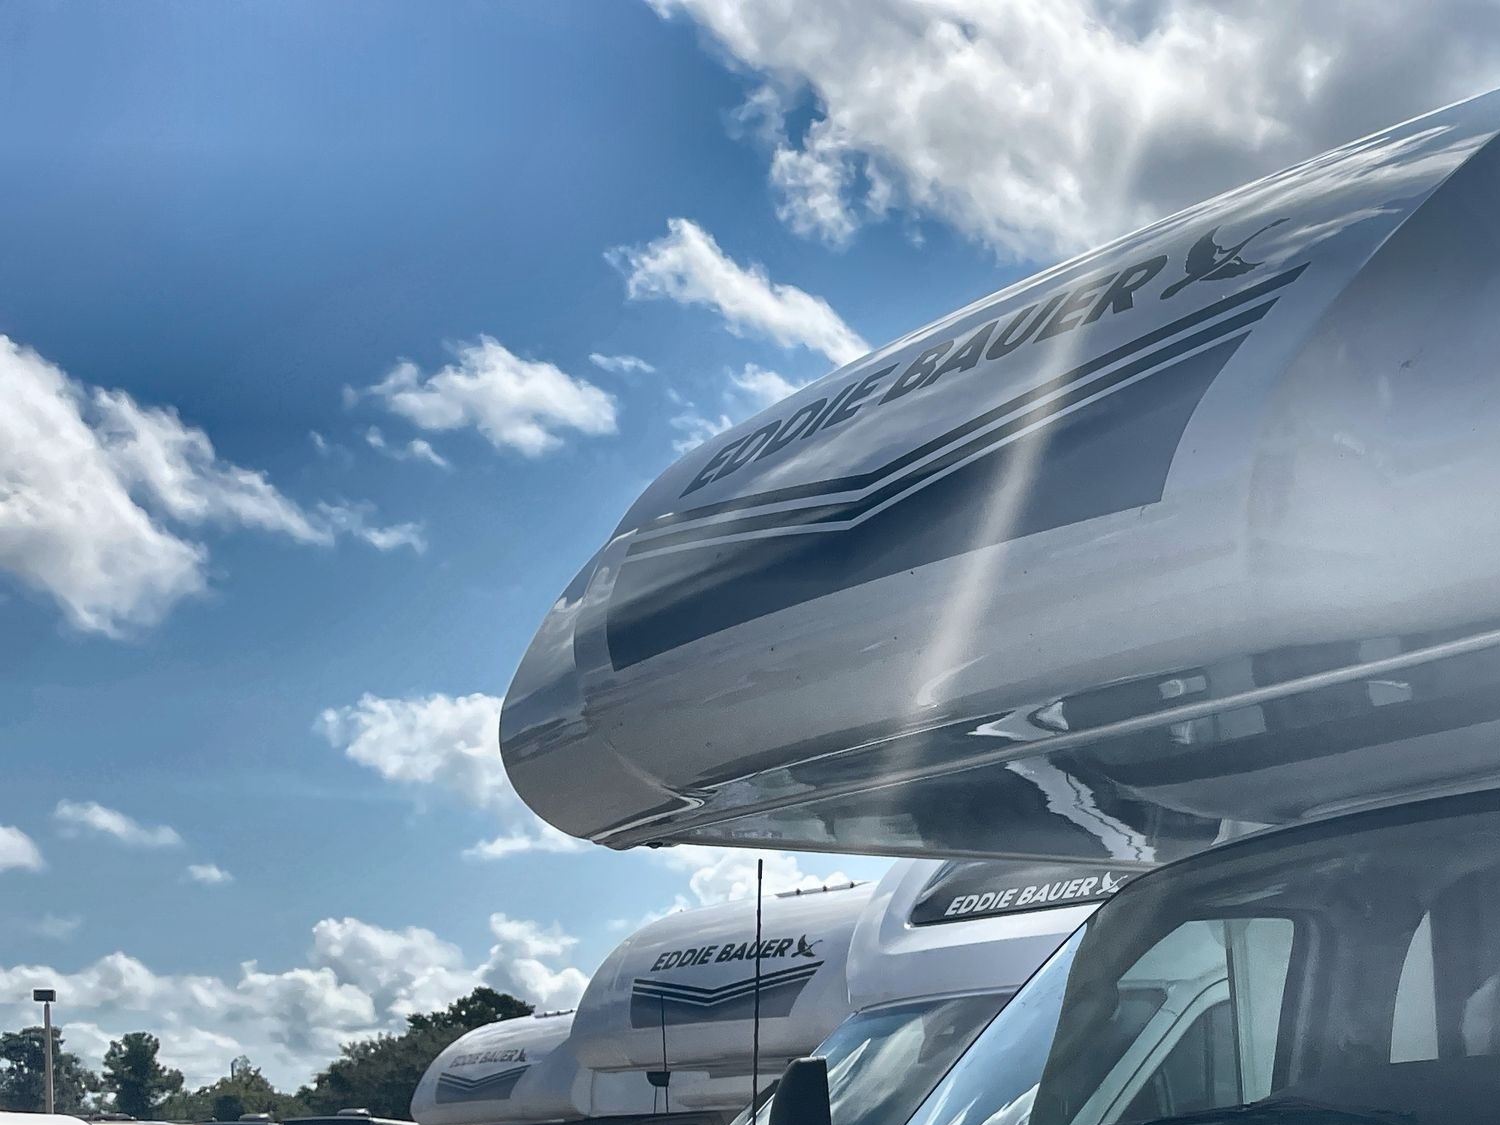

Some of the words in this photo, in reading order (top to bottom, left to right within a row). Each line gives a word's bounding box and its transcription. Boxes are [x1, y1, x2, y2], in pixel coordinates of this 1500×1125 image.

[679, 365, 897, 499] EDDIE
[878, 254, 1168, 406] BAUER
[944, 887, 1019, 917] EDDIE
[1015, 876, 1099, 906] BAUER
[650, 945, 719, 972] EDDIE
[714, 937, 794, 963] BAUER
